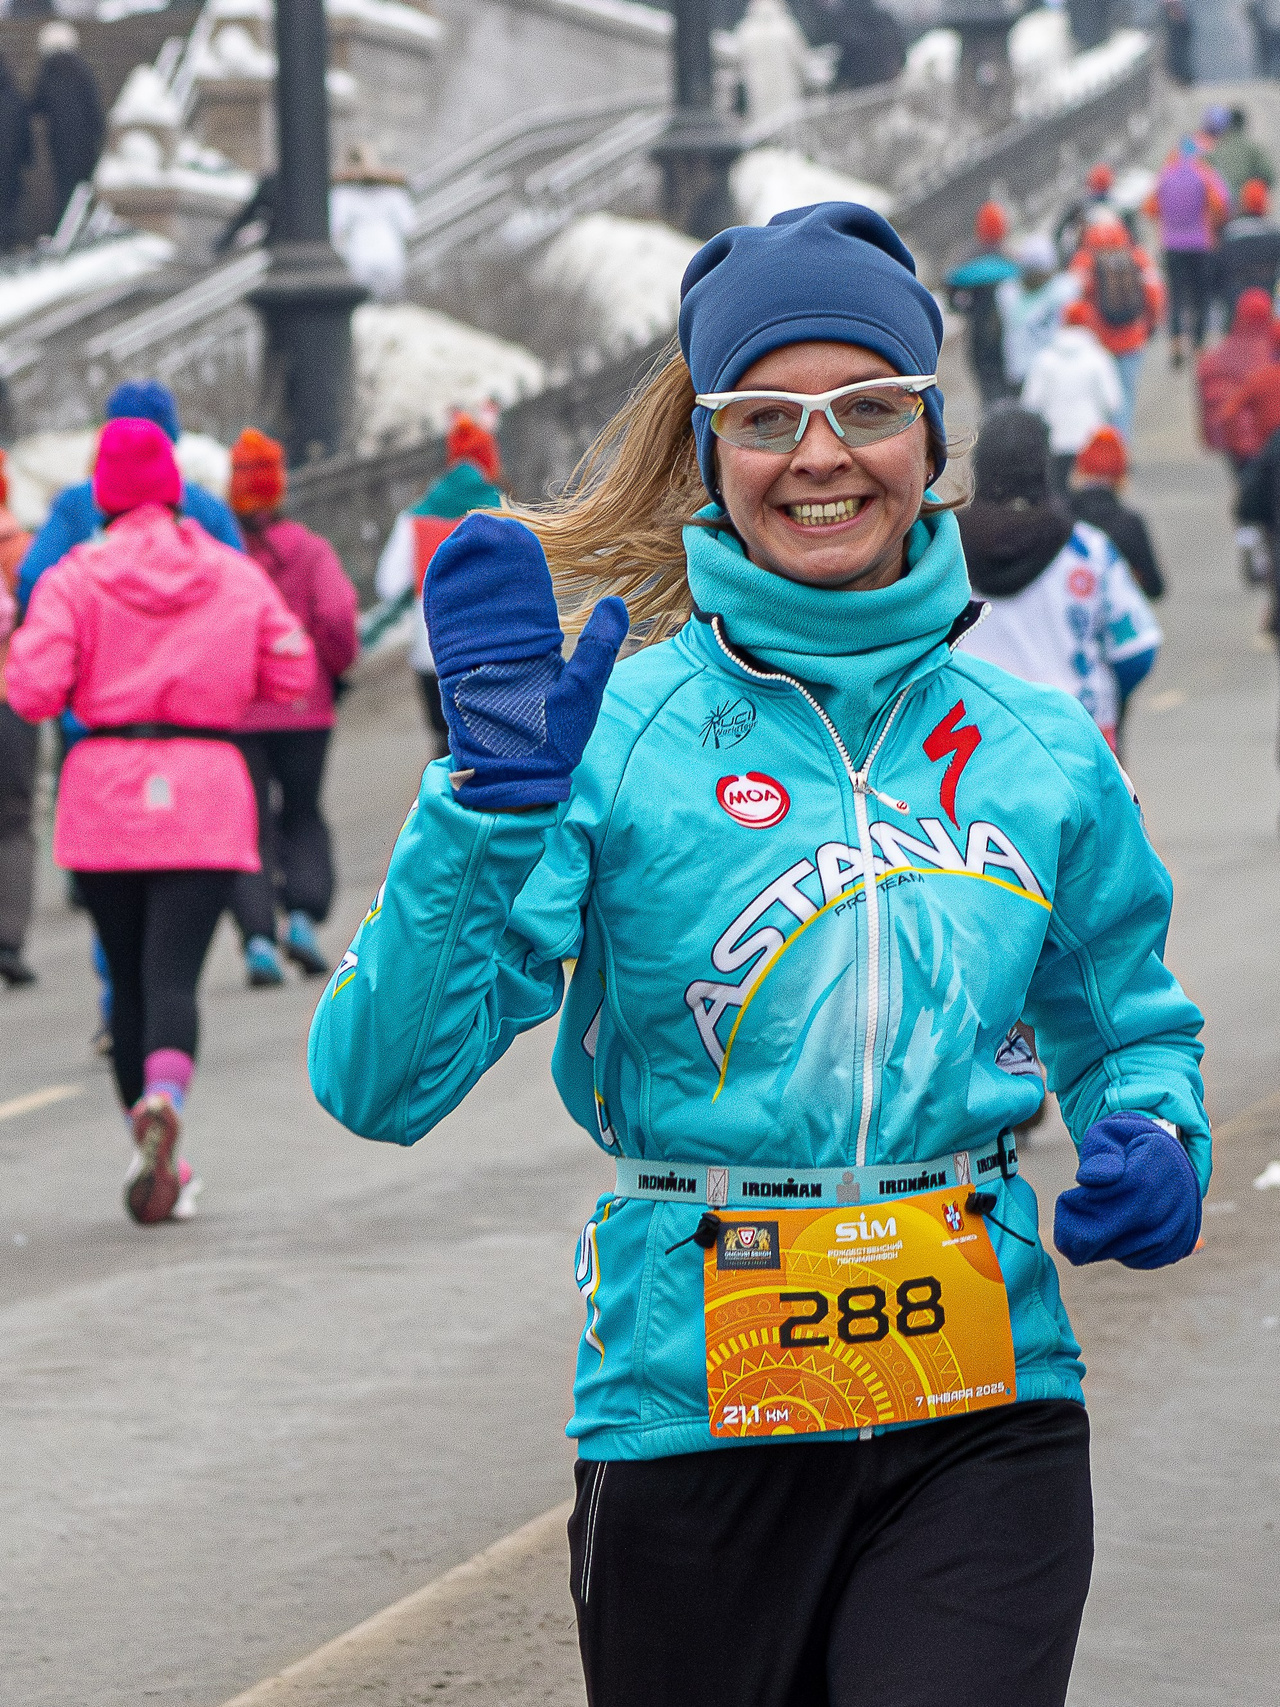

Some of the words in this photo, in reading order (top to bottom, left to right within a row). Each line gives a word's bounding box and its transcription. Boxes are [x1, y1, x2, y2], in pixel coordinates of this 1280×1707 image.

[721, 711, 752, 727] UCI
[729, 789, 780, 805] MOA
[834, 891, 867, 917] PRO
[876, 872, 926, 894] TEAM
[685, 817, 1050, 1078] ASTANA
[638, 1171, 697, 1194] IRONMAN
[741, 1177, 822, 1199] IRONMAN
[878, 1170, 947, 1195] IRONMAN
[778, 1275, 947, 1350] 288
[915, 1396, 924, 1408] 7
[926, 1387, 973, 1406] ЯНВАРЯ
[975, 1381, 1005, 1398] 2025
